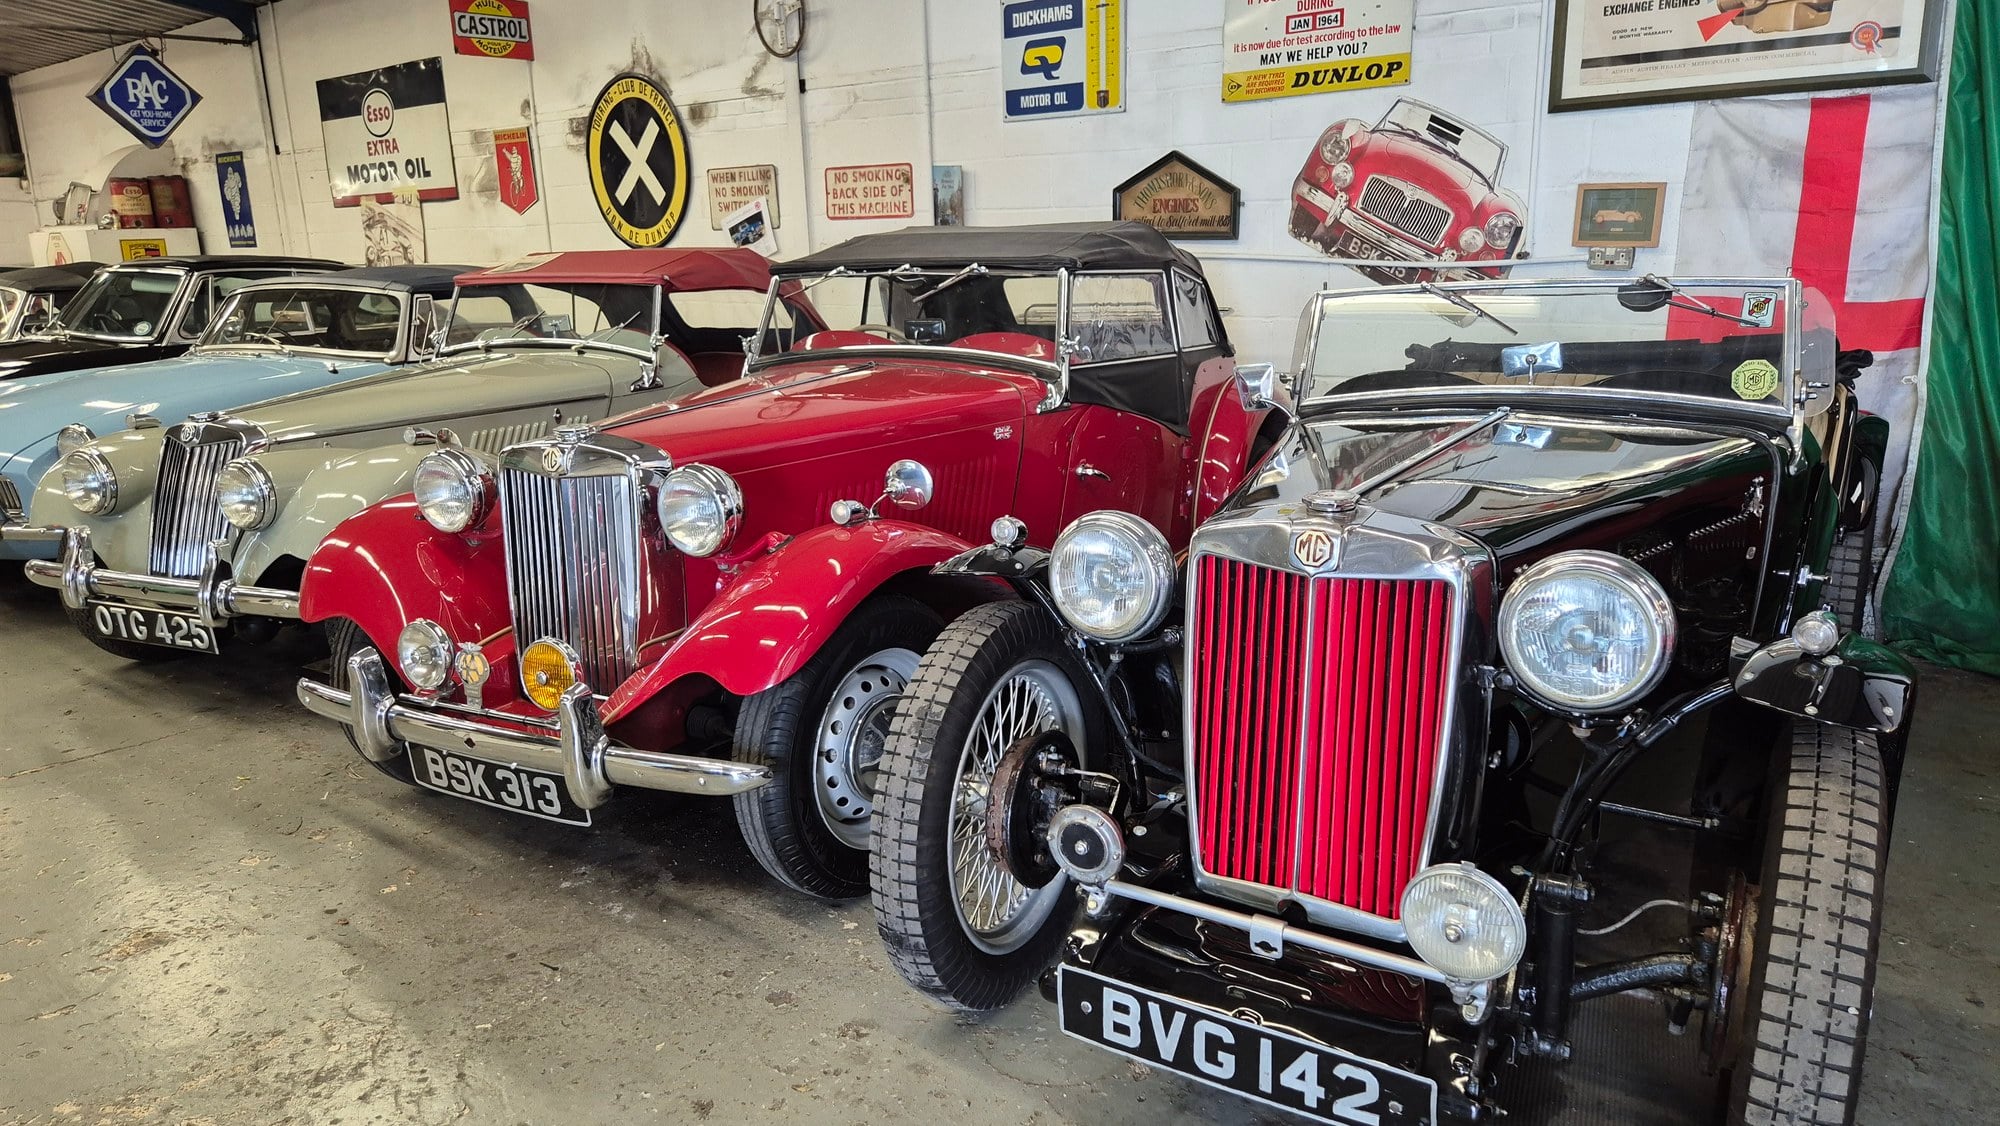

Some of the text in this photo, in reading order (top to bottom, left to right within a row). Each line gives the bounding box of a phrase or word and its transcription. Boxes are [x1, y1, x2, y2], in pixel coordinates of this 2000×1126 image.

[475, 0, 504, 12] HUILE
[1297, 0, 1334, 12] DURING
[1603, 0, 1701, 17] EXCHANGE ENGINES
[1012, 4, 1073, 28] DUCKHAMS
[1291, 14, 1339, 31] JAN 1964
[458, 15, 527, 39] CASTROL
[476, 40, 512, 54] MOTEURS
[1233, 24, 1401, 53] it is now due for test according to the law
[1260, 52, 1282, 66] MAY
[1287, 50, 1302, 62] WE
[1307, 46, 1334, 60] HELP
[1259, 79, 1285, 87] REQUIRED
[1291, 61, 1403, 88] DUNLOP
[125, 72, 169, 109] RAC
[639, 82, 648, 96] DE
[650, 89, 675, 129] FRANCE
[1020, 91, 1068, 109] MOTOR OIL
[140, 119, 167, 127] SERVICE
[366, 138, 400, 156] EXTRA
[346, 157, 431, 184] MOTOR OIL
[711, 169, 772, 184] WHEN FILLING
[834, 169, 901, 184] NO SMOKING
[715, 185, 770, 197] NO SMOKING
[832, 184, 904, 199] BACK SIDE OF
[832, 201, 908, 215] THIS MACHINE
[1152, 198, 1200, 214] ENGINES
[605, 206, 676, 244] DON DE DUNLOP
[1348, 237, 1380, 260] BSK
[543, 450, 558, 469] MG
[1298, 533, 1327, 562] MG
[95, 605, 210, 649] OTG 425
[424, 749, 561, 816] BSK 313
[1103, 987, 1380, 1126] BVG 142
